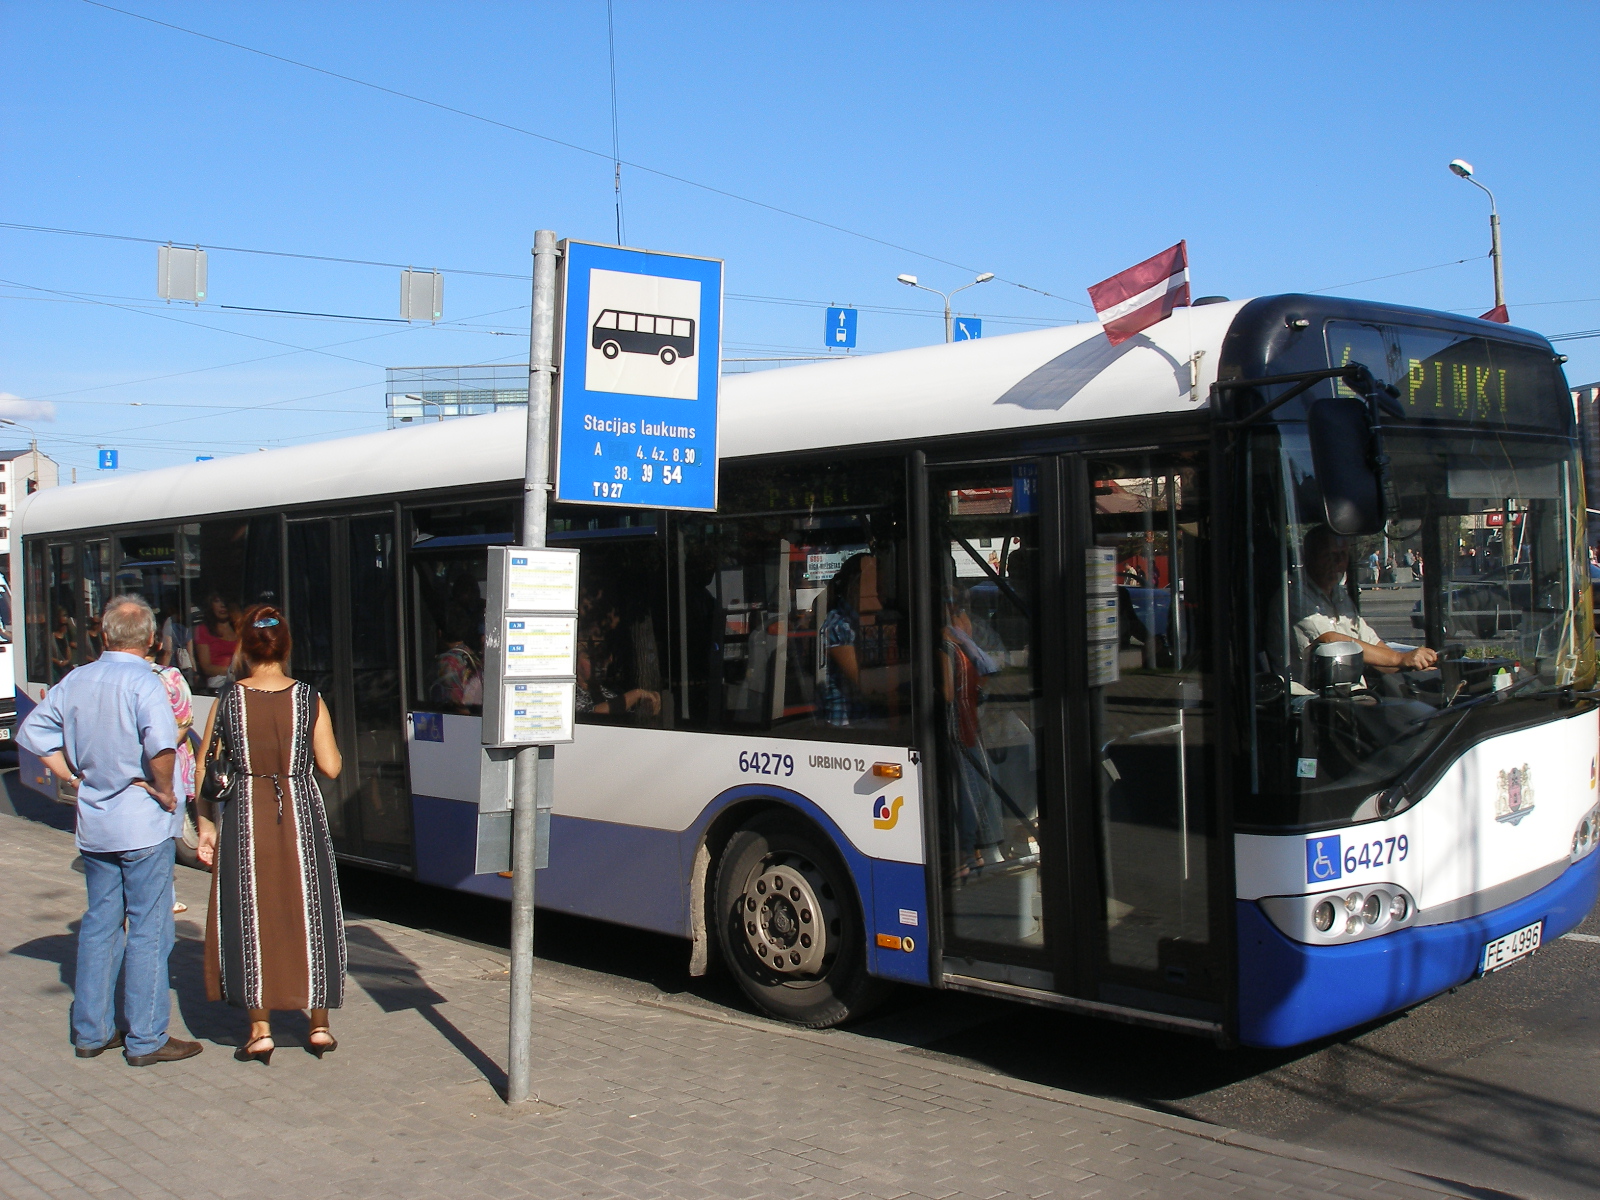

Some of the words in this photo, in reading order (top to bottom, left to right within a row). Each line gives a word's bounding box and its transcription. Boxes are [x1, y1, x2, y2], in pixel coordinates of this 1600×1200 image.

[583, 414, 637, 437] Stacijas
[641, 419, 696, 439] laukums
[594, 441, 602, 456] A
[641, 463, 653, 483] 39
[662, 465, 682, 485] 54
[739, 750, 795, 777] 64279
[808, 754, 852, 771] URBINO
[853, 758, 866, 773] 12
[1344, 834, 1409, 874] 64279
